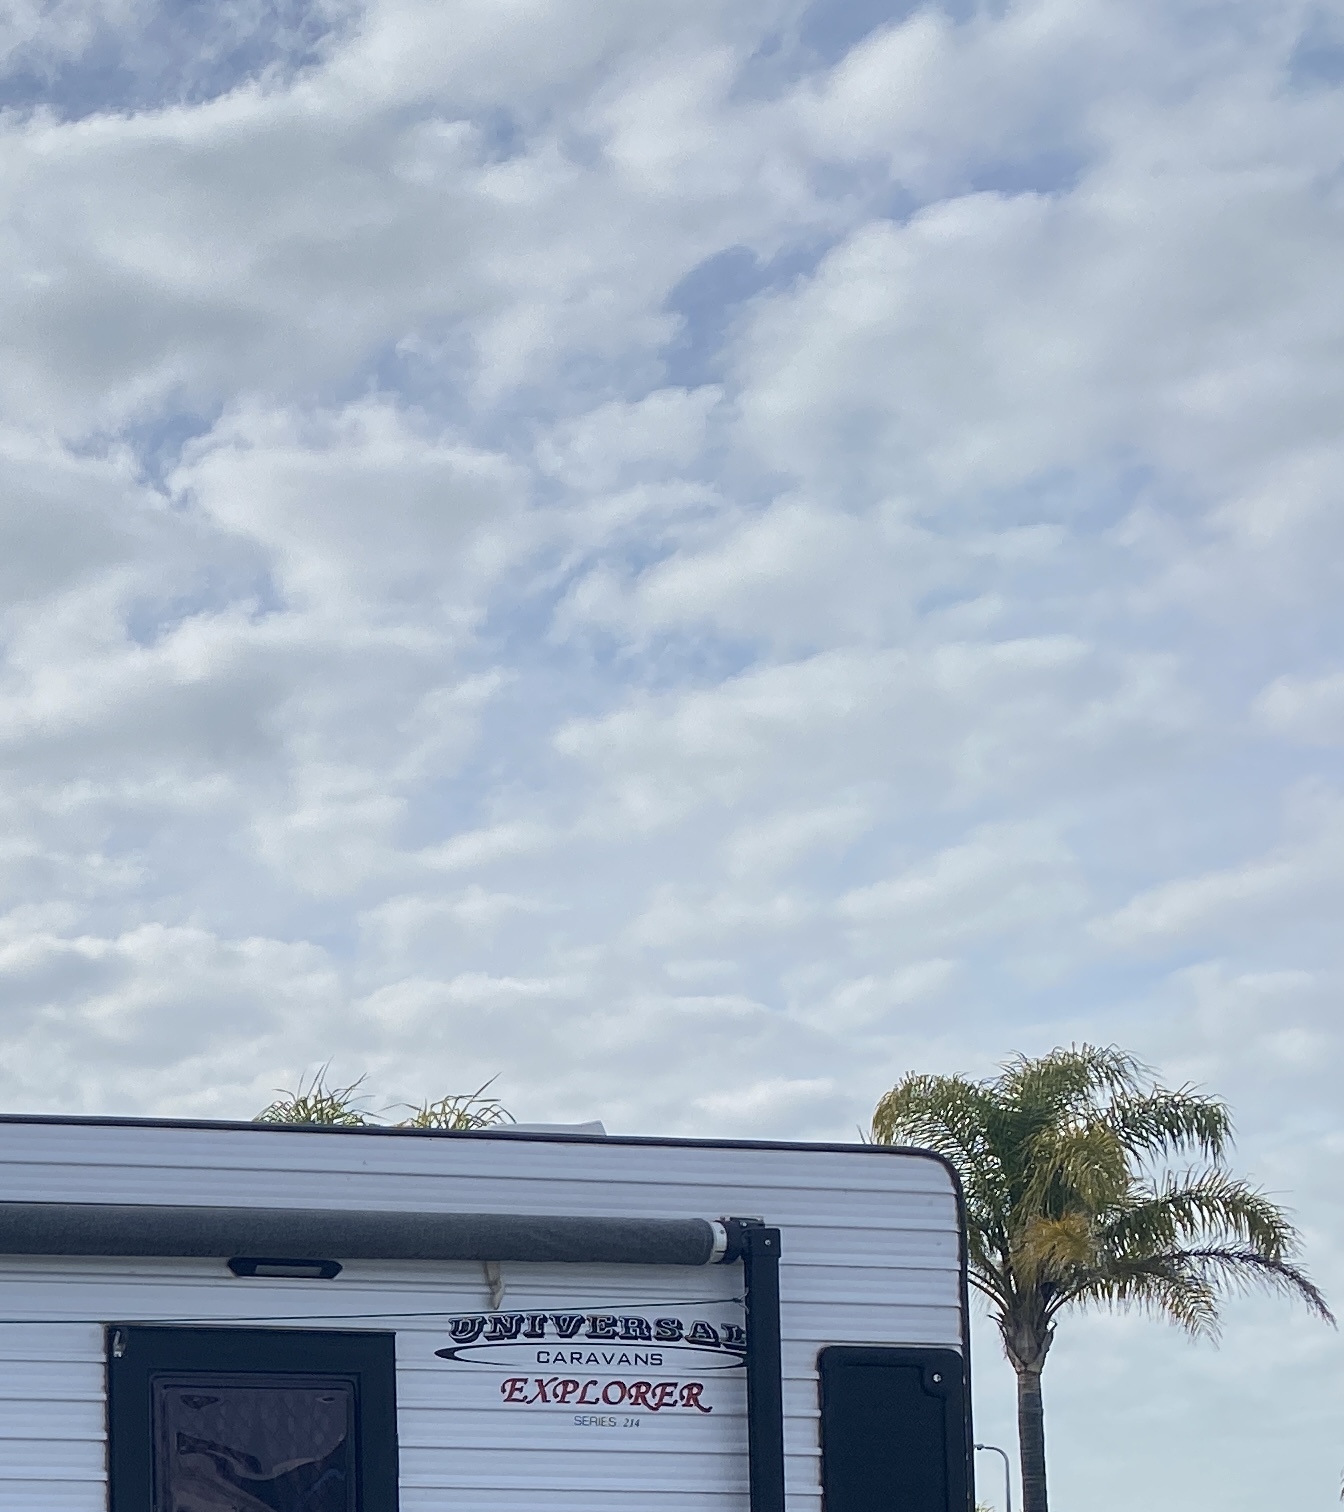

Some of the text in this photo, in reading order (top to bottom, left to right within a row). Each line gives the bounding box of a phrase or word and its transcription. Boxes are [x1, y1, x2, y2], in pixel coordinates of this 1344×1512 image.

[449, 1313, 746, 1351] UNIVERSAL
[536, 1351, 663, 1366] CARAVANS
[500, 1377, 713, 1413] EXPLORER
[574, 1416, 640, 1427] SERIES 214
